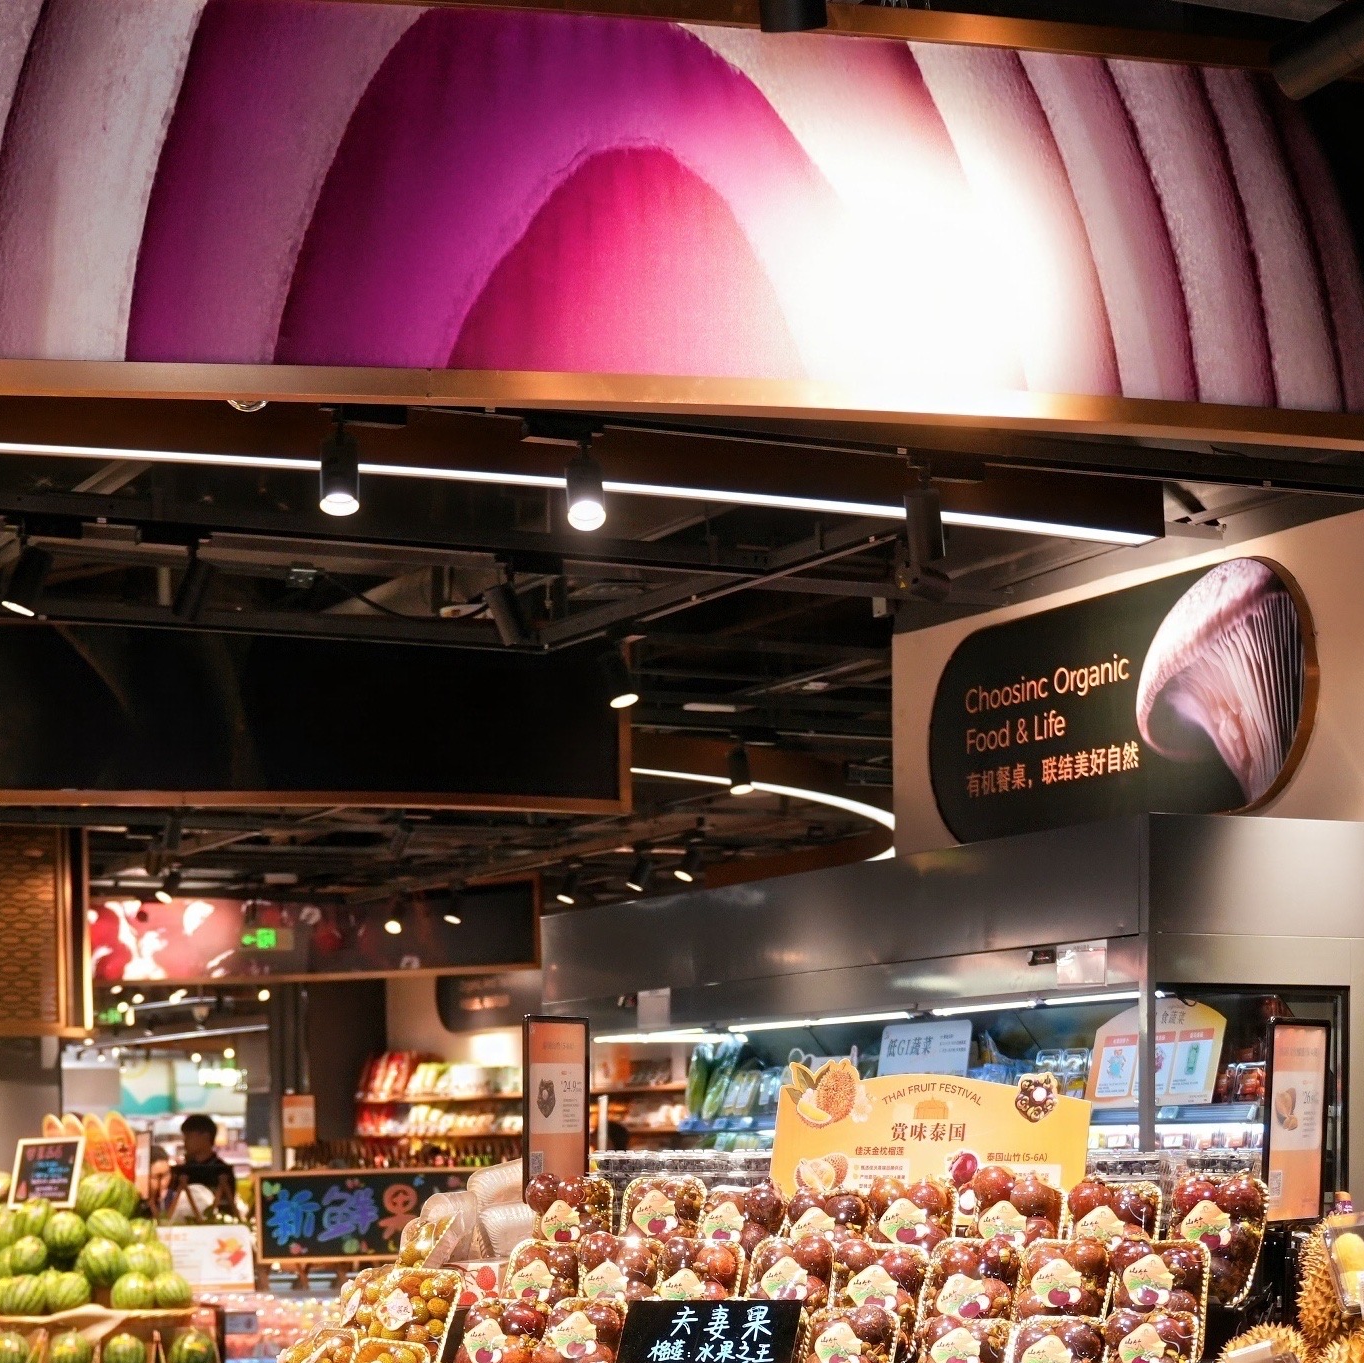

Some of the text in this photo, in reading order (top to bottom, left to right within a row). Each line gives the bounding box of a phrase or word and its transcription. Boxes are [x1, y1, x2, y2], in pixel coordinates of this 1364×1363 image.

[1053, 653, 1130, 697] Organic
[966, 709, 1066, 754] Food & Life
[882, 1082, 982, 1107] THAI FRUIT FESTIVAL
[890, 1122, 967, 1143] 赏味泰国
[670, 1304, 772, 1342] 夫妻果
